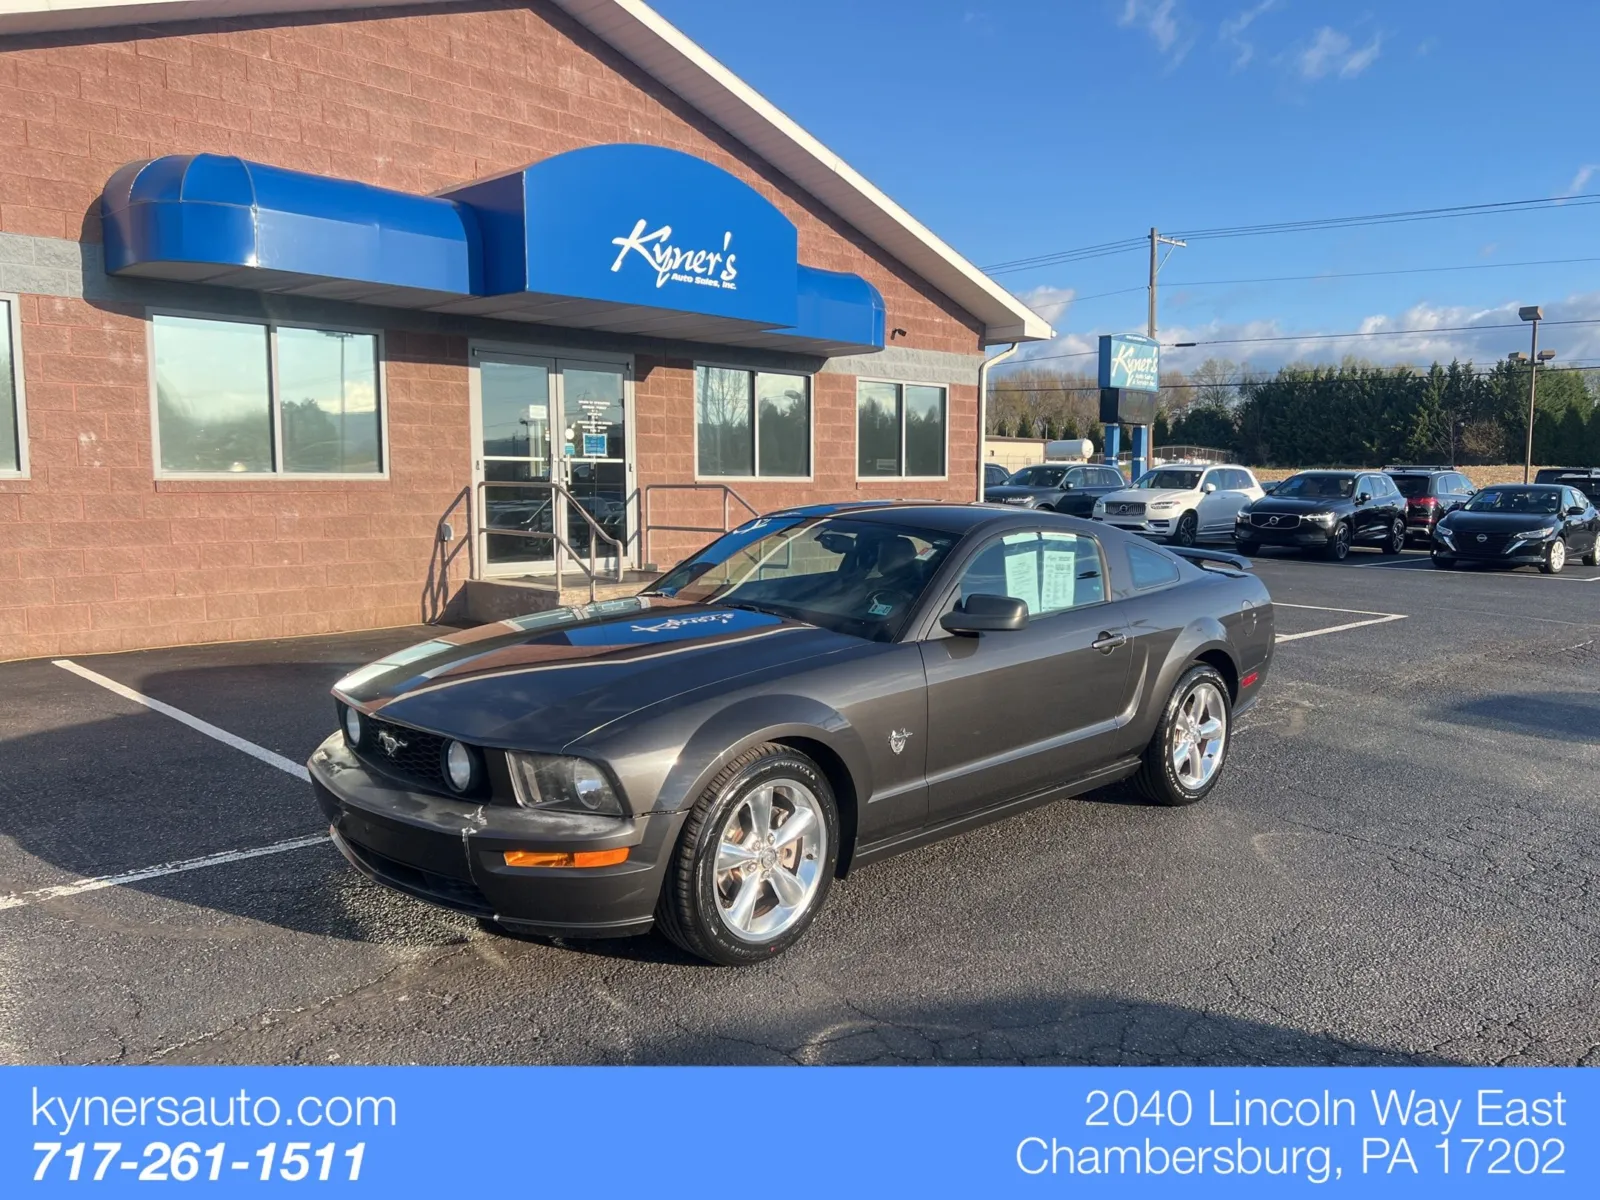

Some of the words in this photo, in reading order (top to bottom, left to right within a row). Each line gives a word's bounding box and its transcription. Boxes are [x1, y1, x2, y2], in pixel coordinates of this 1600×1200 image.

[610, 218, 738, 289] Kyner's
[671, 273, 694, 283] Auto
[694, 276, 720, 288] Sales,
[722, 281, 737, 290] Inc.
[1112, 344, 1158, 387] Kyner's
